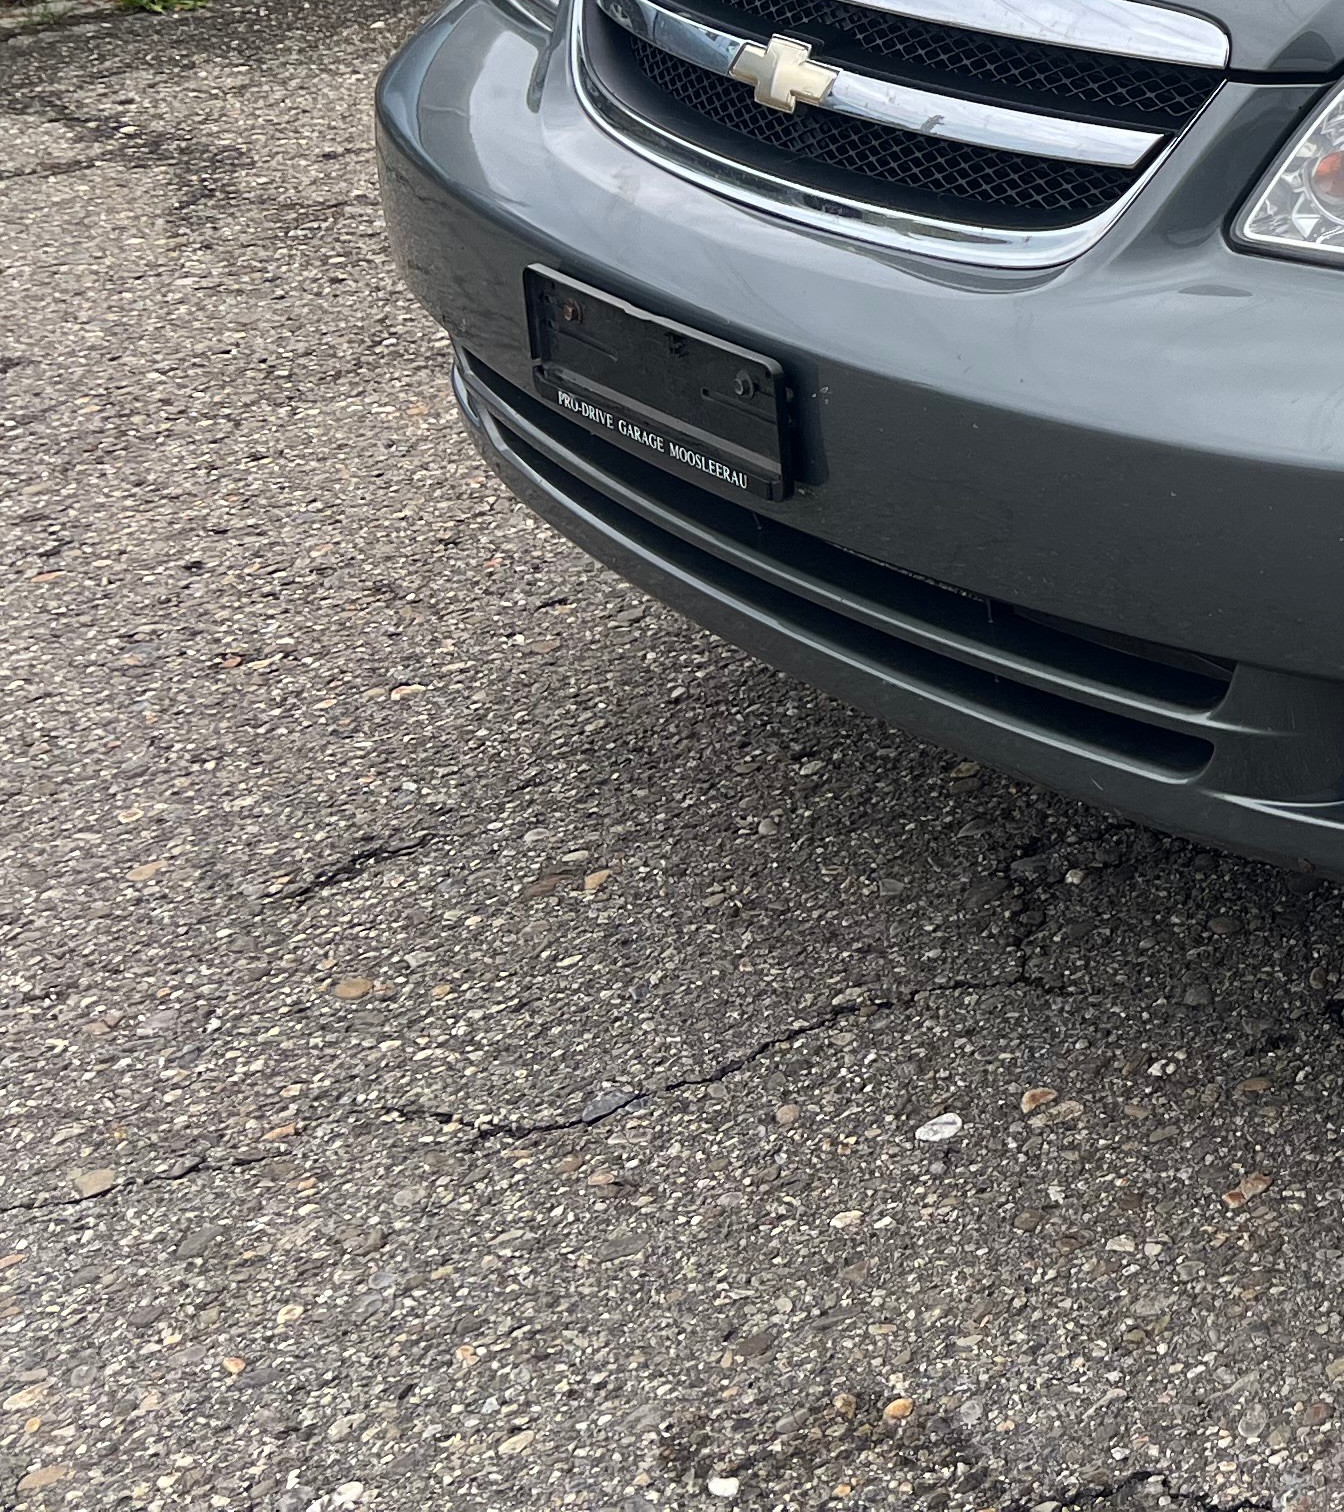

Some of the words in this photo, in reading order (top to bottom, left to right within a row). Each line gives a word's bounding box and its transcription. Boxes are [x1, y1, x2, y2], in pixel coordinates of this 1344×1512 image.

[557, 390, 615, 430] PRO-DRIVE
[618, 419, 665, 453] GARAGE
[669, 442, 749, 489] MOOSLEERAU
